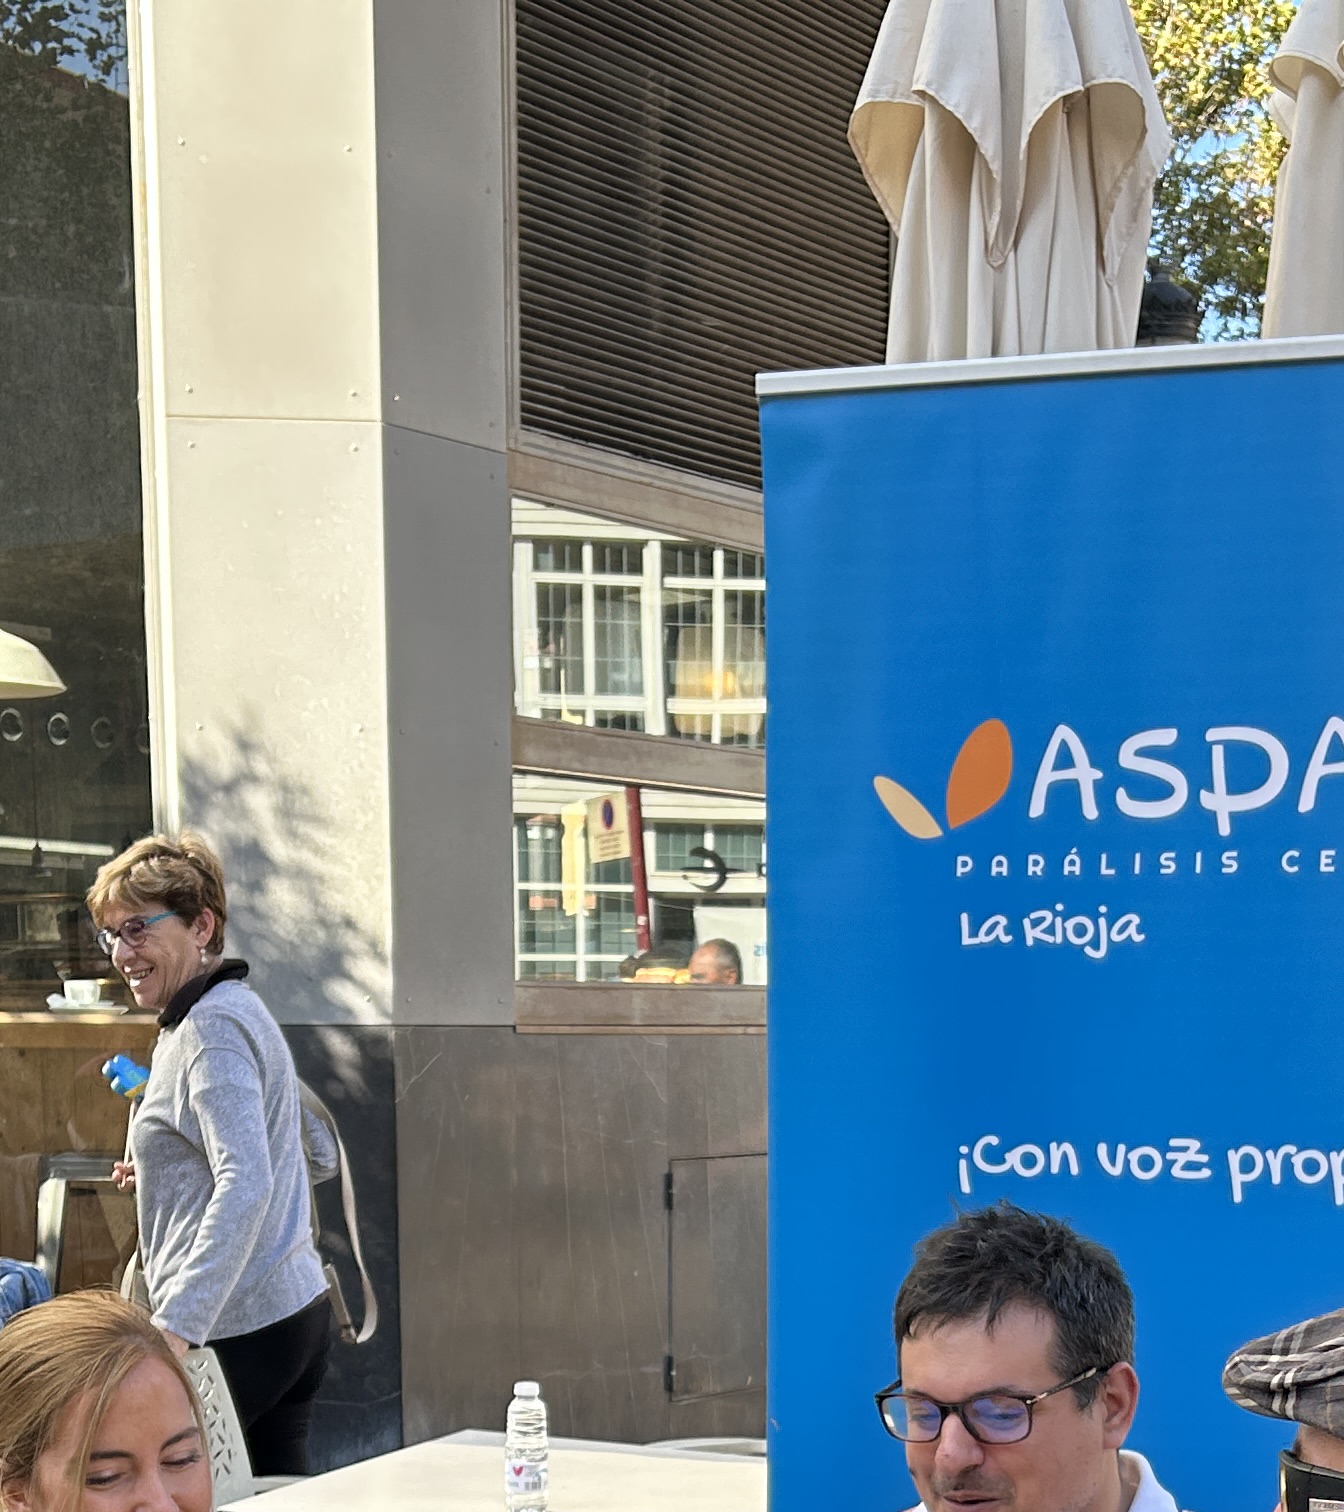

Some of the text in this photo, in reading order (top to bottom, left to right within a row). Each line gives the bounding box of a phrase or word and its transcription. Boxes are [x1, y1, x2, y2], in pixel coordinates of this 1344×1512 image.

[956, 847, 1240, 877] PARÁLISIS
[960, 903, 1146, 958] La Rioja
[958, 1135, 1079, 1194] ¡Con
[1096, 1138, 1212, 1182] voz
